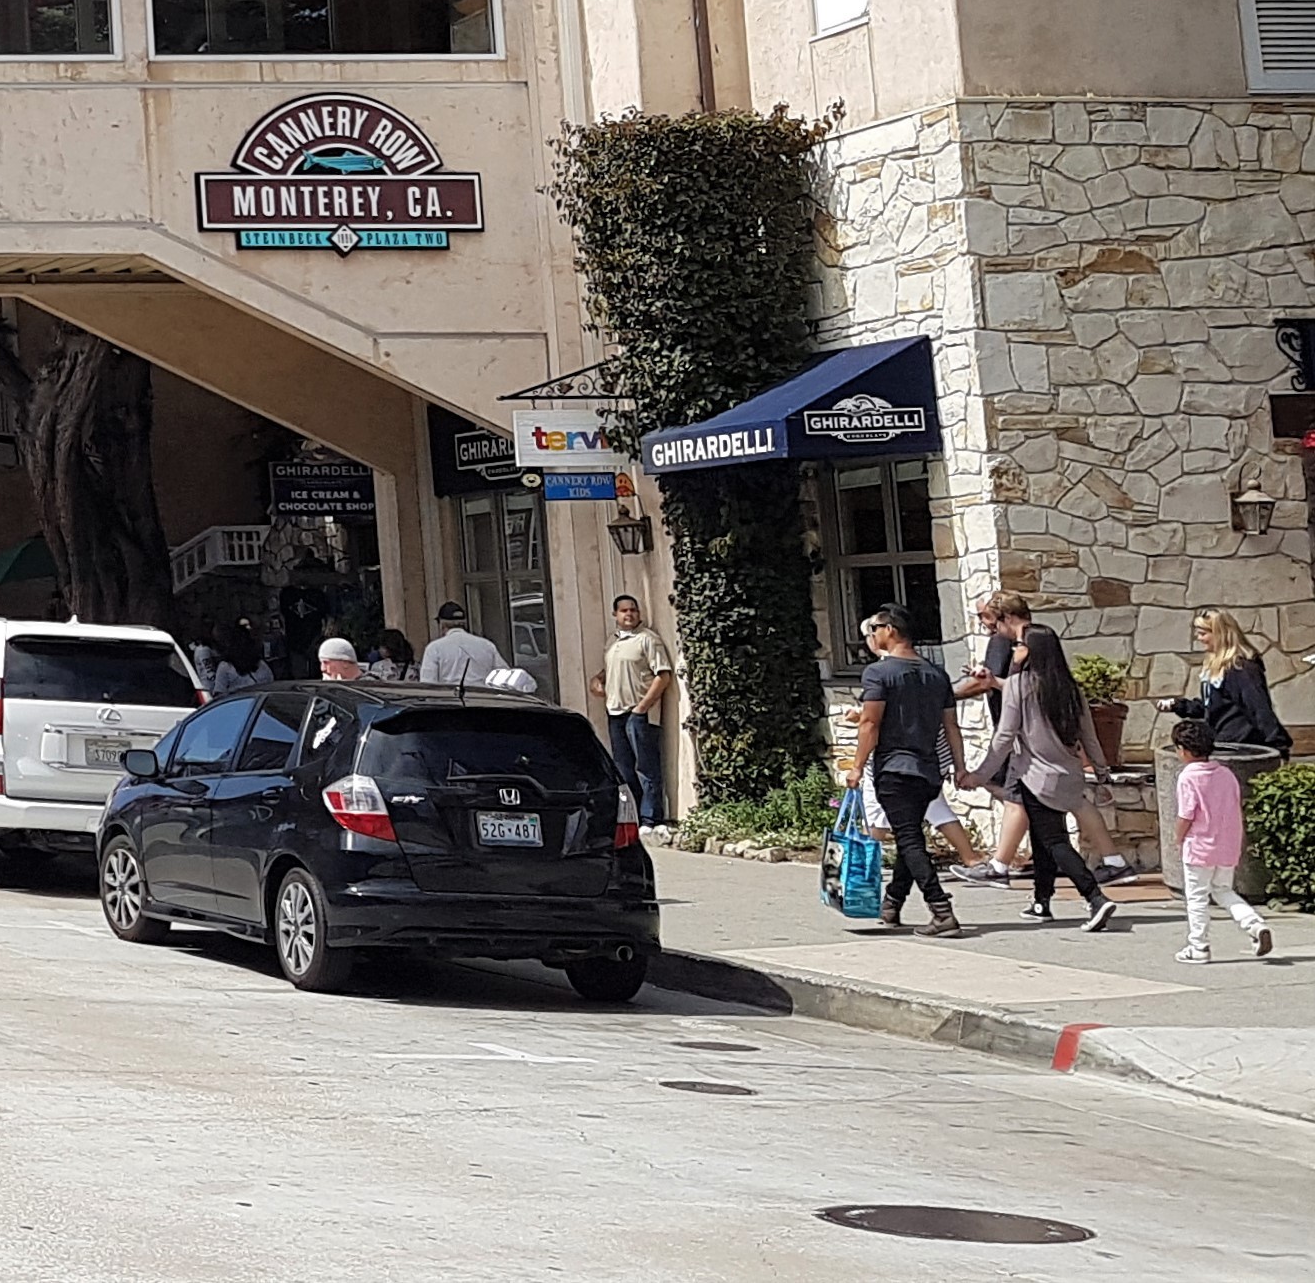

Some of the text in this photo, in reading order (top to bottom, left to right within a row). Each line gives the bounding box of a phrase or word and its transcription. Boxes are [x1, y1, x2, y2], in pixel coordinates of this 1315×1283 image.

[253, 106, 426, 171] CANNERY ROW
[232, 186, 453, 221] MONTEREY, CA.
[244, 232, 323, 245] STEINBECK
[367, 232, 409, 245] PLAZA
[416, 233, 443, 245] TWO
[810, 413, 920, 430] GHIRARDELLI
[651, 427, 776, 467] GHIRARDELLI
[276, 466, 371, 476] GHIRARDELLI
[546, 475, 612, 487] CANNERY ROW
[291, 491, 308, 499] ICE
[311, 490, 350, 499] CREAM
[568, 487, 591, 497] KIDS
[278, 502, 375, 511] CHOCOLATE SHOP
